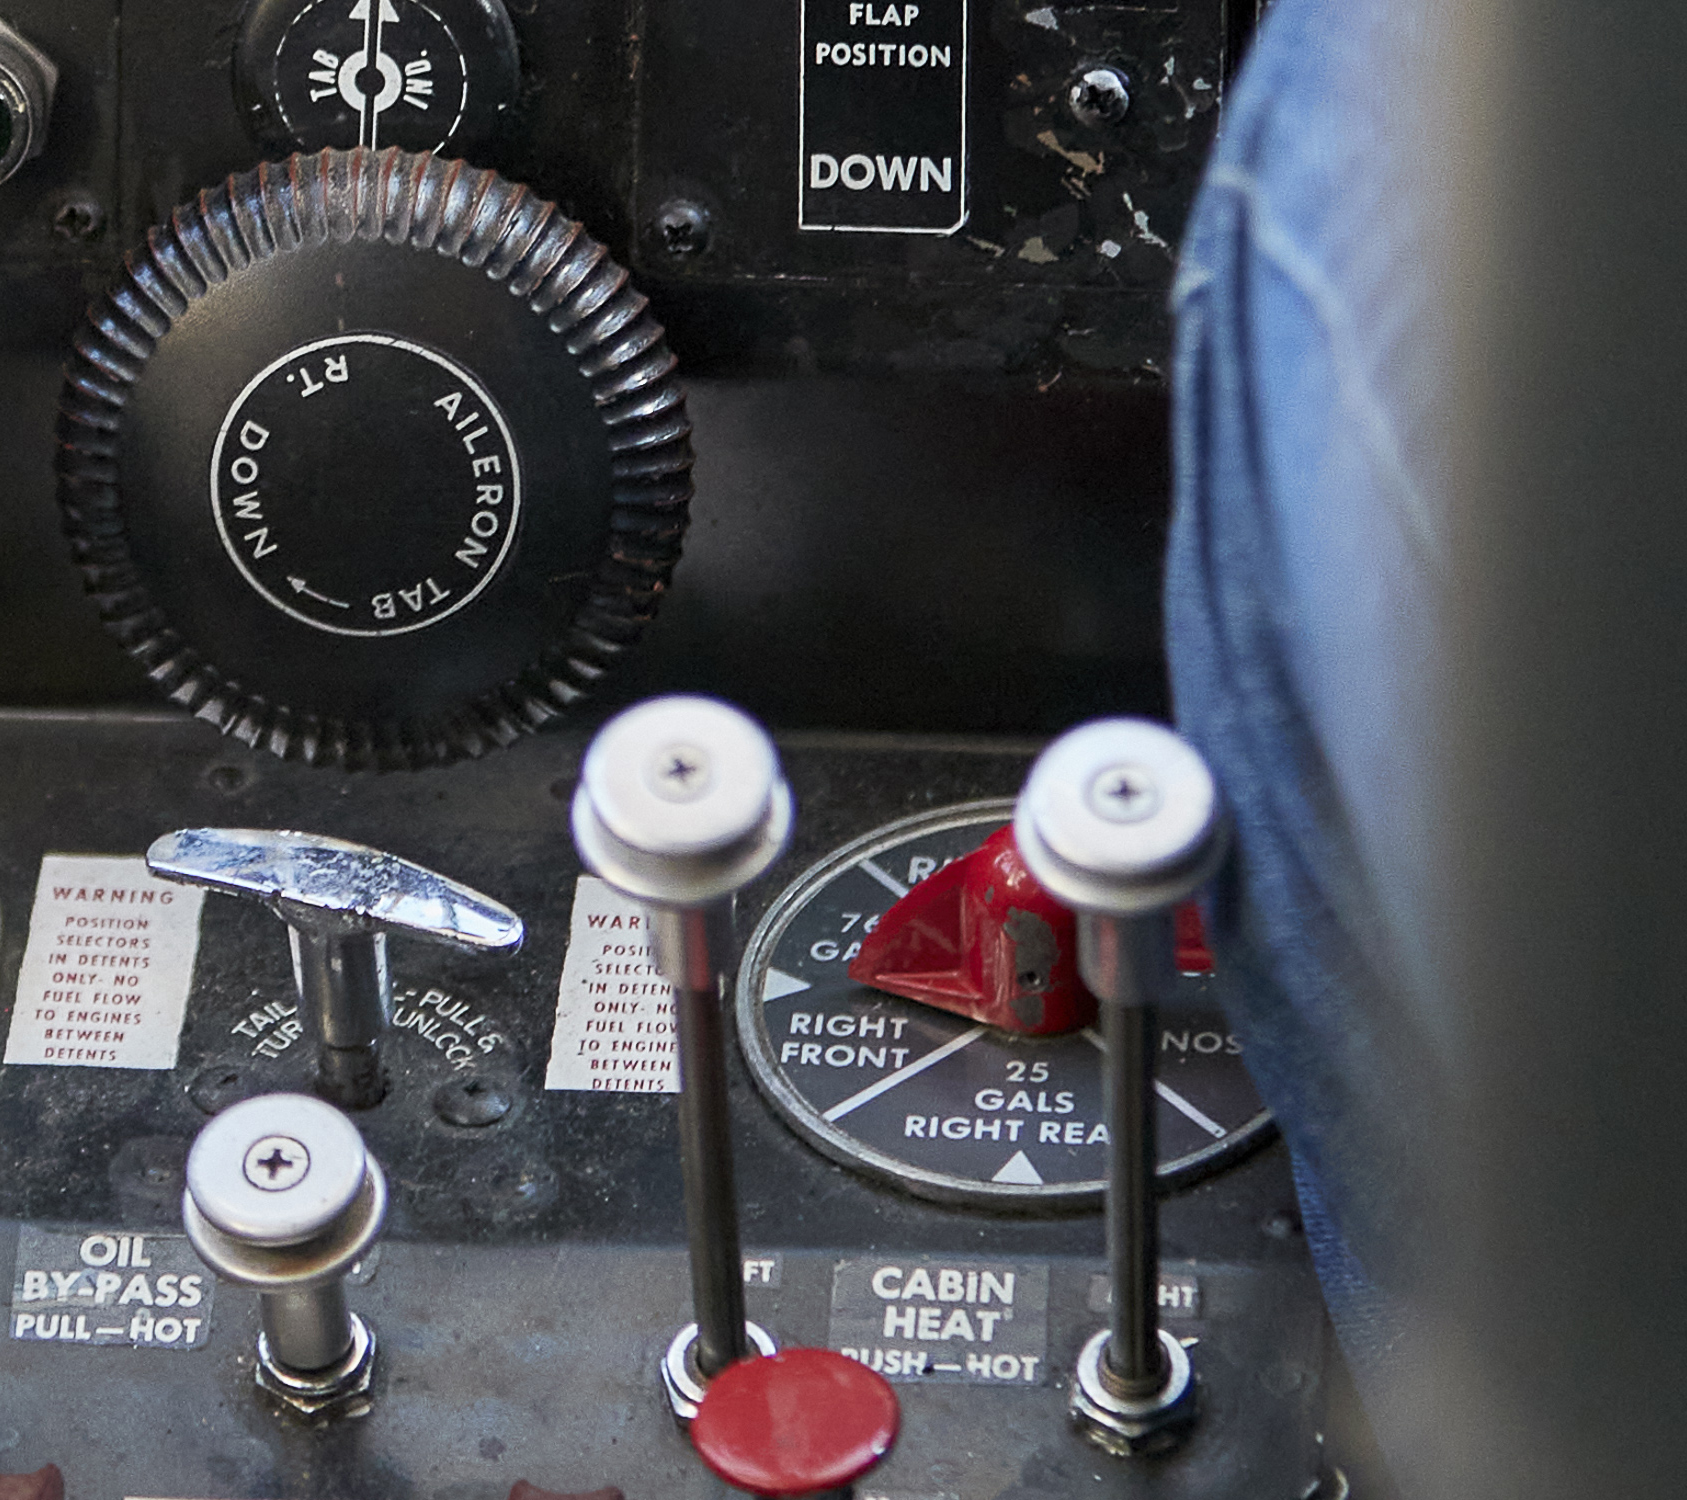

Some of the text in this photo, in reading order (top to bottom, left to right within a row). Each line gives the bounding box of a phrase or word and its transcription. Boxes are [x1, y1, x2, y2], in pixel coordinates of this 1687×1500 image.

[849, 3, 919, 26] FLAP
[815, 44, 951, 67] POSITION
[308, 47, 340, 103] TAB
[810, 155, 952, 192] DOWN
[286, 354, 349, 399] RT.
[231, 420, 277, 560] DOWN
[434, 391, 504, 569] AILERON
[371, 576, 451, 620] TAB
[53, 887, 174, 905] WARNING
[65, 917, 149, 929] POSITION
[56, 935, 150, 949] SELECTORS
[49, 954, 150, 968] IN DETENTS
[114, 976, 139, 987] NO
[588, 982, 607, 994] IN
[43, 991, 141, 1005] FUEL FLOW
[35, 1010, 141, 1024] TO ENGINES
[231, 1001, 298, 1039] TAIL
[419, 988, 487, 1037] PULL
[44, 1029, 125, 1042] BETWEEN
[585, 1020, 624, 1033] FUEL
[789, 1013, 909, 1039] RIGHT
[44, 1048, 116, 1061] DETENTS
[579, 1040, 600, 1052] TO
[780, 1045, 910, 1069] FRONT
[590, 1059, 671, 1072] BETWEEN
[1006, 1061, 1049, 1083] 25
[592, 1079, 665, 1091] DETENTS
[974, 1090, 1075, 1113] GALS
[903, 1116, 1109, 1144] RIGHT REA
[80, 1237, 151, 1267] OIL
[22, 1271, 202, 1308] BY-PASS
[871, 1267, 1015, 1304] CABIN
[884, 1306, 1001, 1341] HEAT
